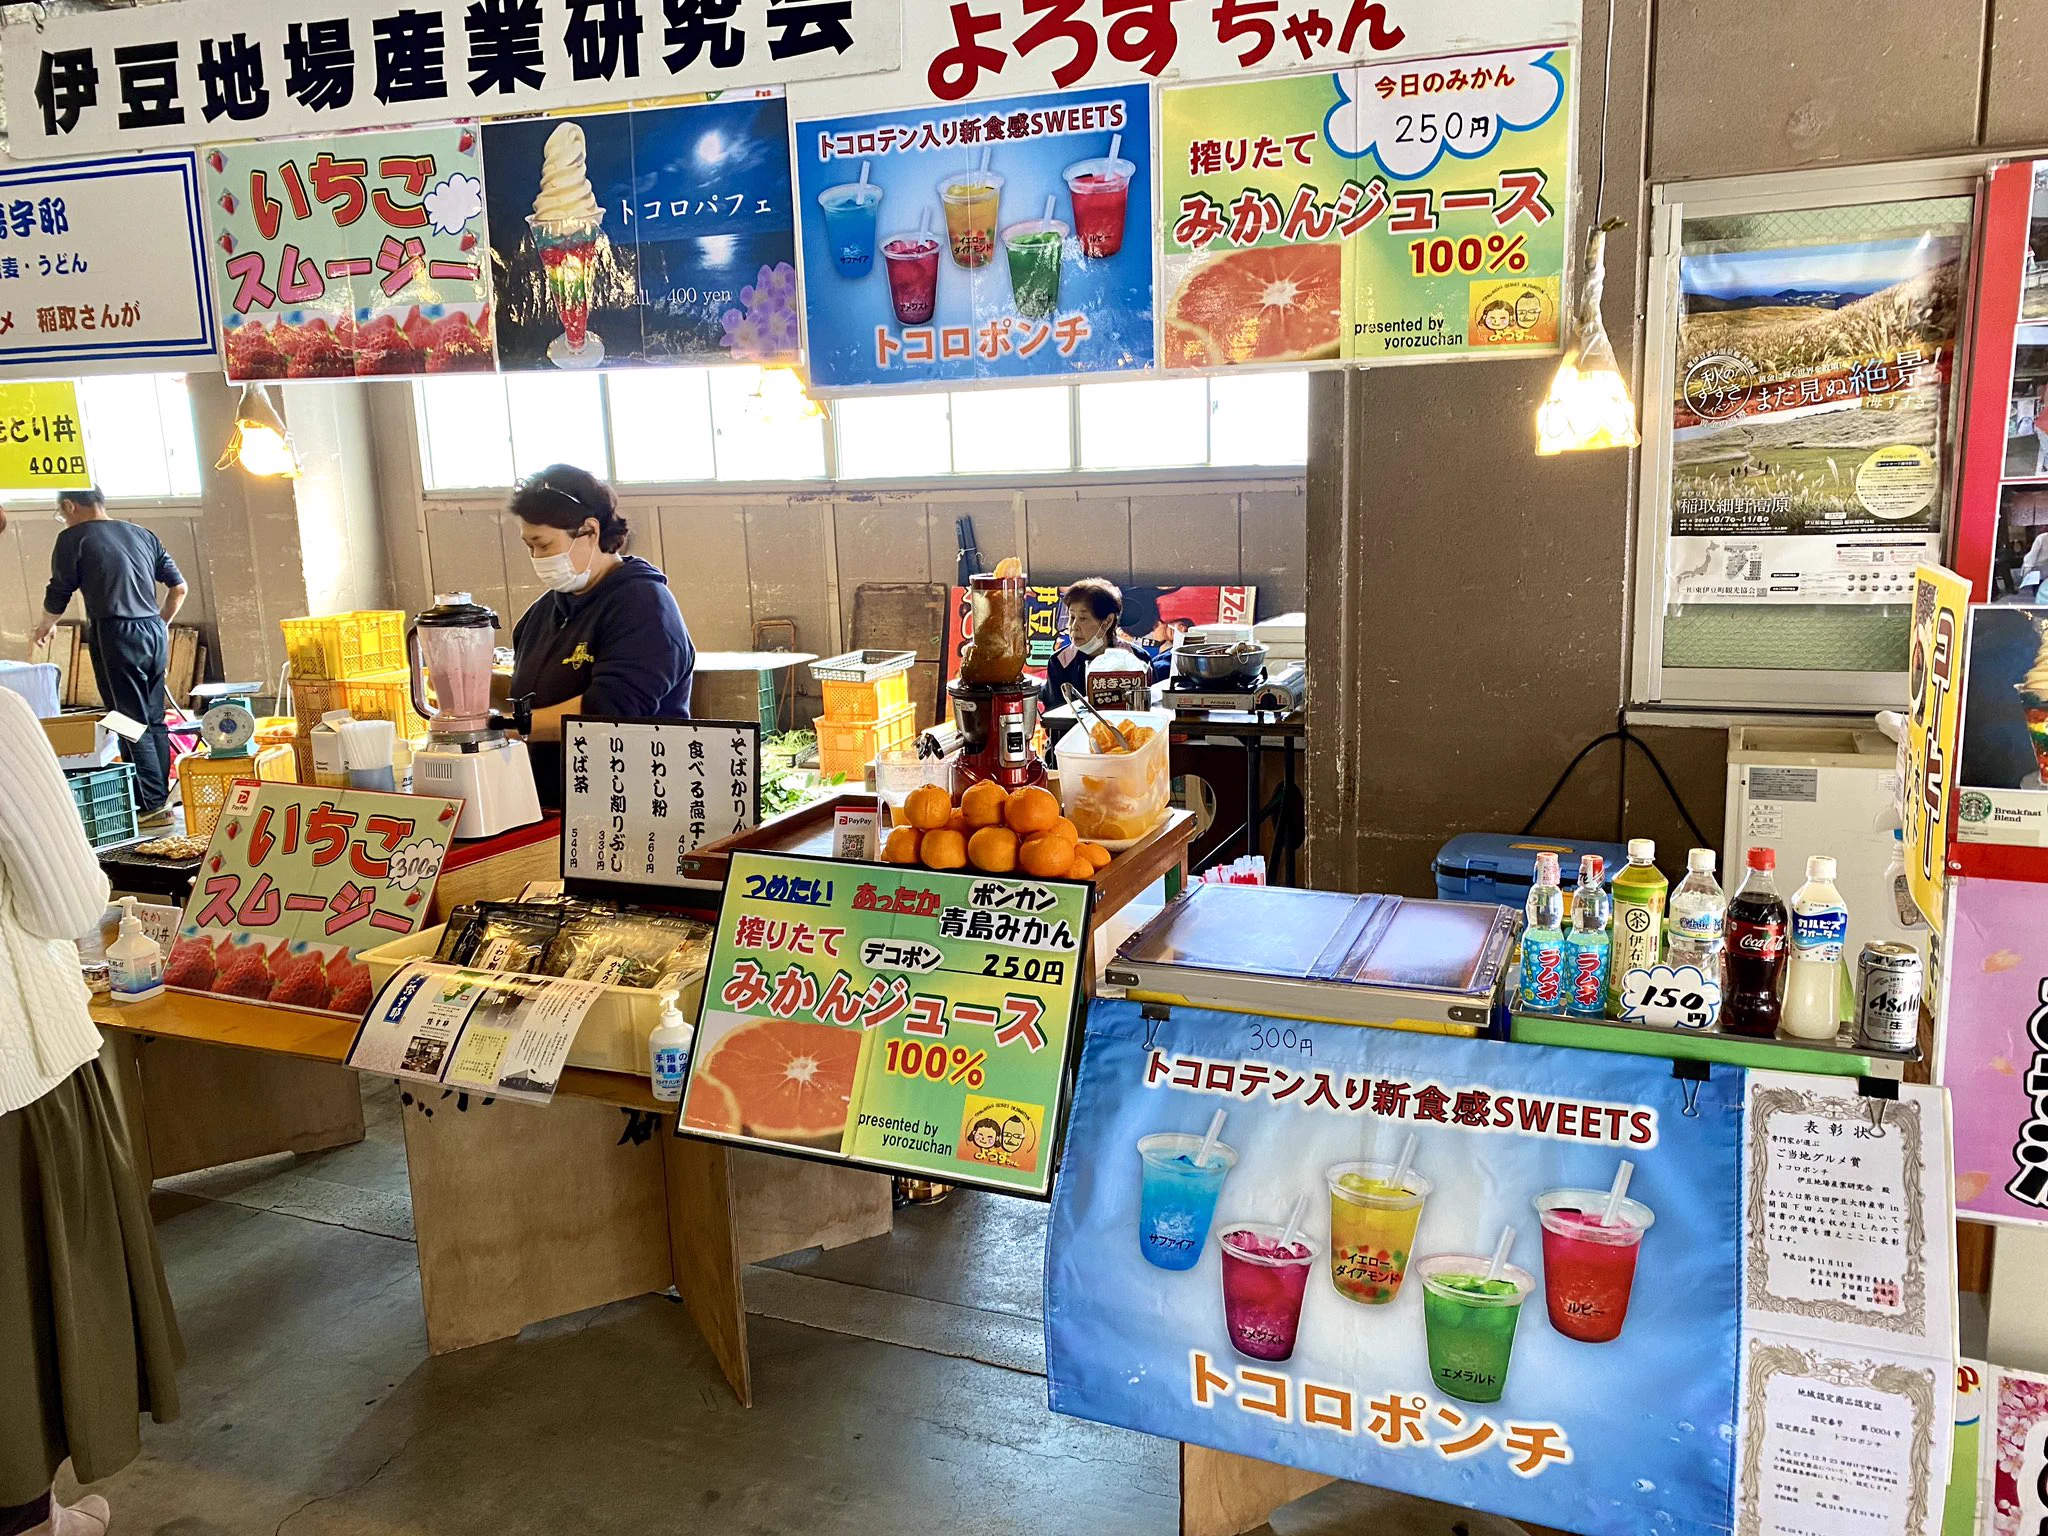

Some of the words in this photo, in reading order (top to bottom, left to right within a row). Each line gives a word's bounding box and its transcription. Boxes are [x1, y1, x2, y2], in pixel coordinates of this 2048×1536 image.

[1374, 65, 1516, 98] 今日のみかん
[821, 104, 1124, 158] トコロテン入り新食感SWEETS
[1395, 111, 1491, 143] 250円
[1190, 132, 1317, 175] 搾りたて
[250, 152, 436, 240] いちご
[621, 194, 773, 225] トコロパフェ
[1172, 168, 1554, 248] みかんジュース
[0, 252, 88, 280] 麦・うどん
[1408, 233, 1529, 277] 100%
[226, 234, 482, 315] スムージー
[667, 287, 697, 304] 400
[703, 289, 731, 306] yen
[36, 300, 141, 333] 稲取さんが
[1354, 316, 1424, 336] presented
[1428, 316, 1445, 332] by
[877, 315, 1089, 366] トコロポンチ
[1384, 332, 1463, 350] yorozuchan
[29, 456, 86, 475] 400円
[1680, 497, 1791, 514] 稲取細野高原
[1093, 677, 1142, 690] 焼きとり
[573, 736, 589, 794] そば茶
[650, 741, 668, 818] いわし粉
[231, 803, 249, 812] PayPay
[609, 737, 627, 873] いわし削りぶし
[1994, 807, 2042, 817] Breakfast
[1994, 814, 2022, 823] Blend
[848, 816, 873, 826] PayPay
[247, 800, 416, 880] いちご
[569, 828, 578, 868] 540円
[596, 831, 606, 871] 330円
[645, 832, 655, 874] 260円
[195, 872, 416, 937] スムージー
[743, 873, 834, 906] つめたい
[852, 882, 942, 917] あったか
[971, 883, 1057, 911] ポンカン
[735, 915, 846, 957] 搾りたて
[940, 906, 1077, 950] 青島みかん
[1629, 912, 1647, 930] 茶
[1798, 918, 1842, 932] カルピス
[1798, 929, 1840, 939] ウォーター
[863, 945, 943, 972] デコポン
[982, 953, 1064, 984] 250円
[1537, 949, 1561, 1001] ラムネ
[1575, 953, 1600, 1006] ラムネ
[722, 957, 1049, 1053] みかんジュース
[1249, 1024, 1314, 1057] 300円
[884, 1037, 988, 1090] 100%
[1145, 1050, 1653, 1146] トコロテン入り新食感SWEETS
[858, 1112, 919, 1136] presented
[923, 1120, 939, 1137] by
[1803, 1120, 1871, 1140] 表彰状
[882, 1133, 952, 1156] yorozuchan
[1771, 1134, 1820, 1147] 専門家が選ぶ
[1776, 1149, 1862, 1168] ご当地グルメ賞
[1778, 1163, 1829, 1175] トコロポンチ
[1148, 1232, 1196, 1252] サファイア
[1334, 1262, 1402, 1287] ダイアモンド
[1346, 1252, 1391, 1269] イエロー
[1566, 1299, 1606, 1318] ルビー
[1237, 1327, 1287, 1347] アメジスト
[1440, 1366, 1497, 1386] エメラルド
[1191, 1350, 1571, 1474] トコロポンチ
